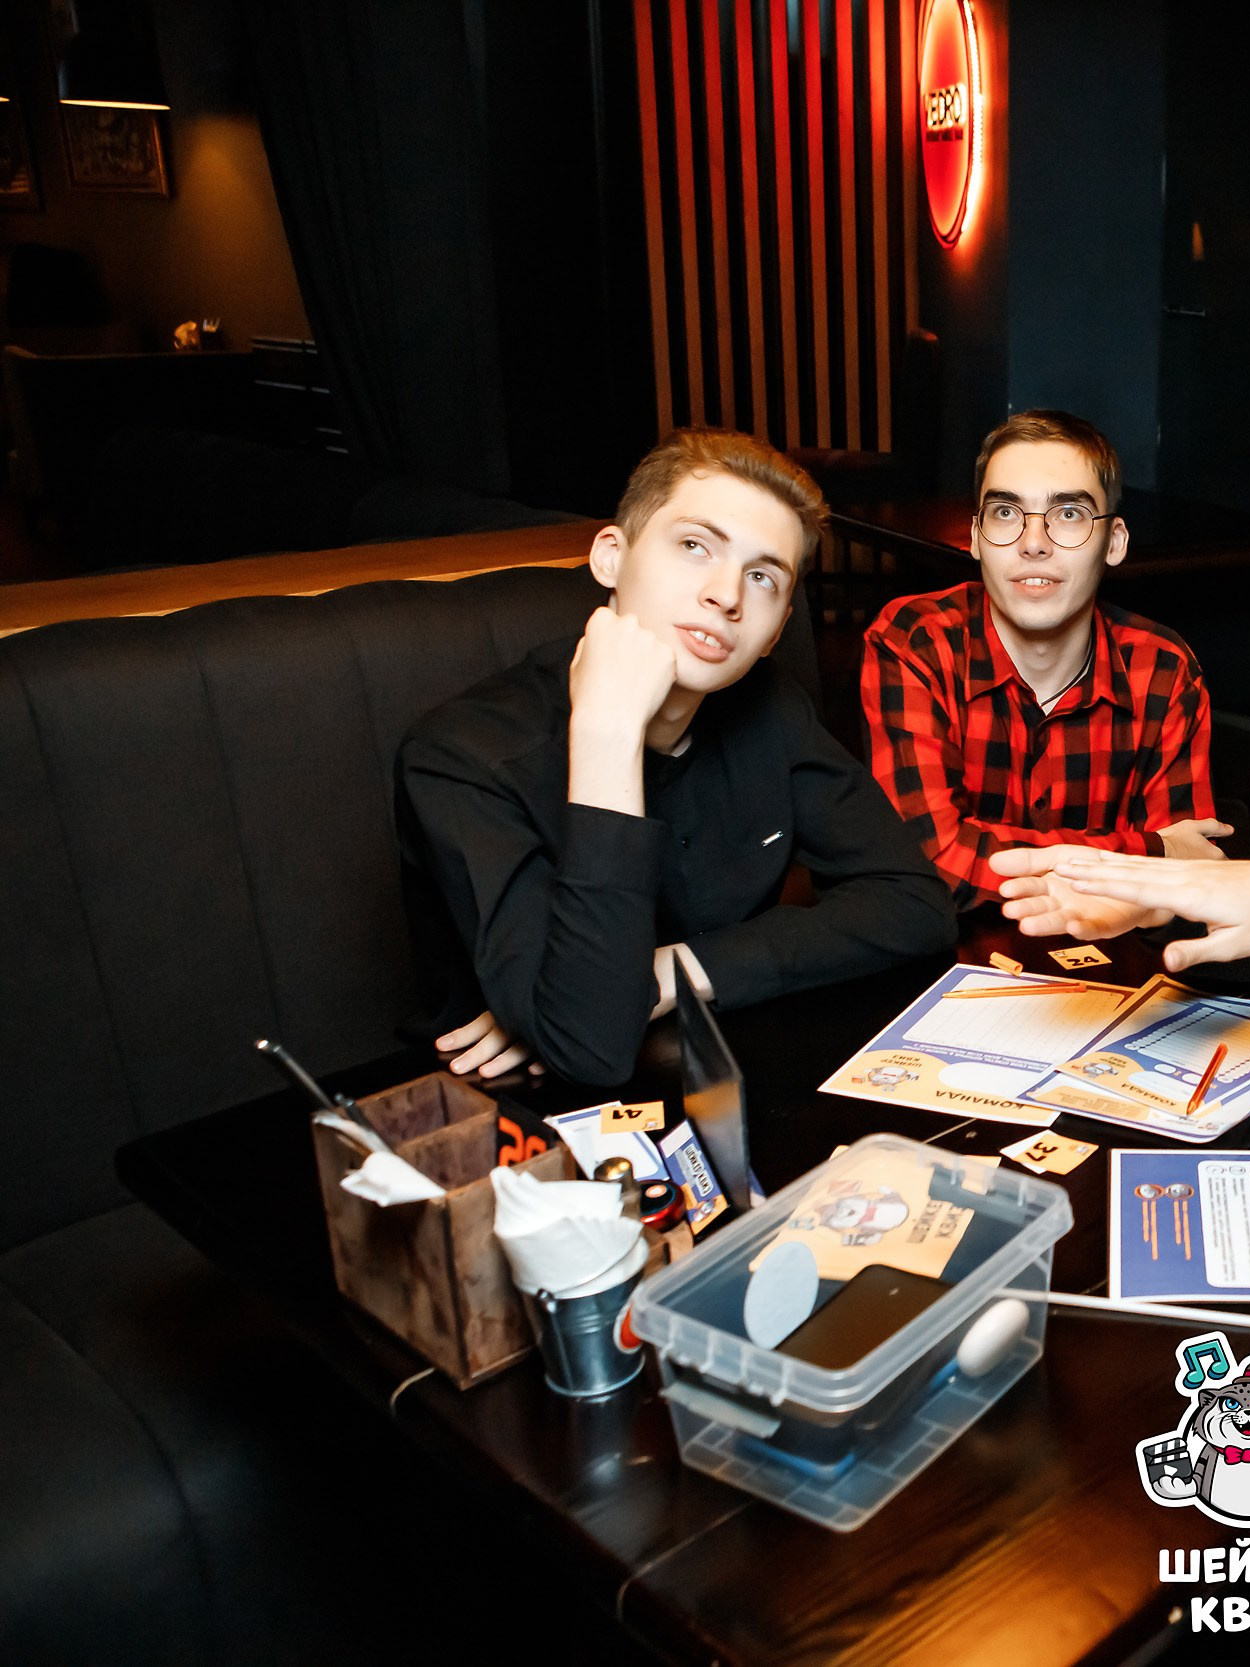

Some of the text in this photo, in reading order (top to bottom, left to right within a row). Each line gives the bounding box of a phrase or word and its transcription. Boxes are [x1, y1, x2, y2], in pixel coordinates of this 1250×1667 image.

[1066, 956, 1099, 966] 24
[935, 1090, 1025, 1110] КОМАНДА
[612, 1109, 643, 1120] 41
[1025, 1142, 1059, 1162] 37
